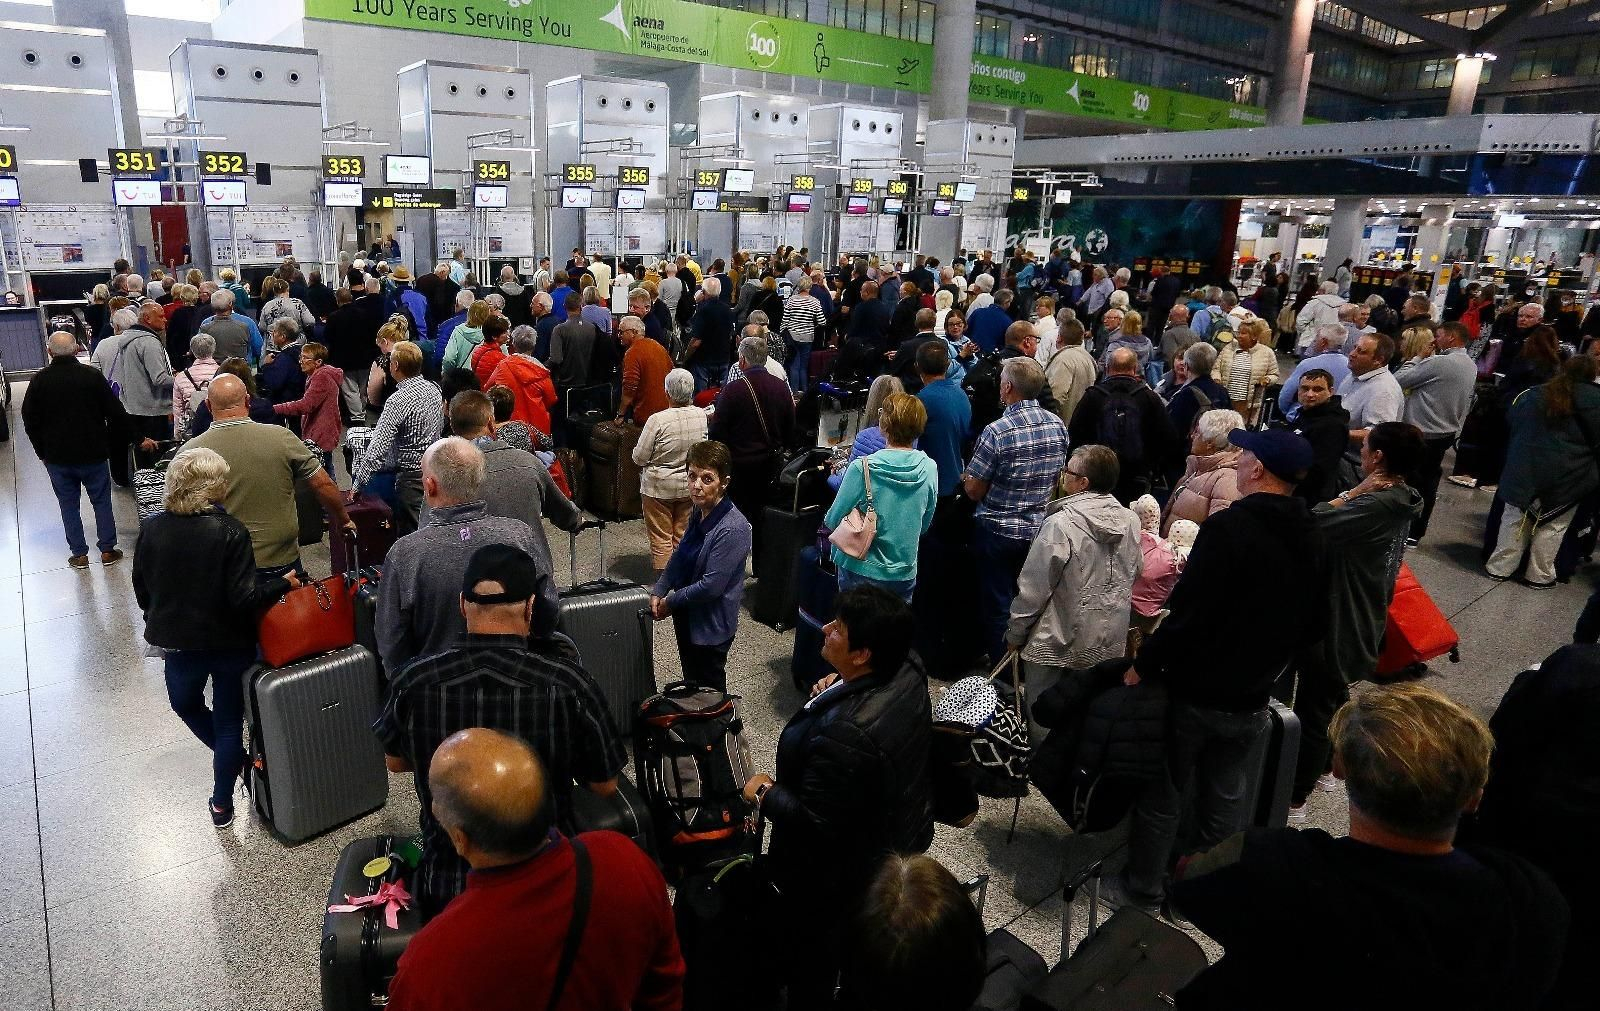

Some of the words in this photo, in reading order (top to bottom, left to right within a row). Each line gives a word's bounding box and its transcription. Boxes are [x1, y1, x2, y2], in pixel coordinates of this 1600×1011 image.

[404, 0, 457, 23] Years
[464, 6, 533, 37] Serving
[539, 15, 571, 37] You
[633, 15, 665, 31] aena
[640, 30, 679, 44] Aeropuerto
[680, 36, 688, 44] de
[750, 32, 776, 57] 100
[640, 39, 686, 54] Málaga-Costa
[687, 46, 698, 55] del
[698, 48, 710, 57] Sol
[992, 66, 1026, 84] contigo
[995, 84, 1026, 104] Serving
[1029, 89, 1044, 104] You
[1132, 90, 1150, 112] 100
[115, 152, 156, 171] 351
[205, 154, 244, 173] 352
[327, 158, 362, 175] 353
[478, 163, 508, 179] 354
[567, 166, 594, 181] 355
[622, 168, 647, 183] 356
[698, 172, 721, 186] 357
[794, 176, 814, 190] 358
[854, 179, 872, 192] 359
[889, 181, 907, 194] 360
[939, 184, 954, 197] 361
[1013, 188, 1028, 200] 362
